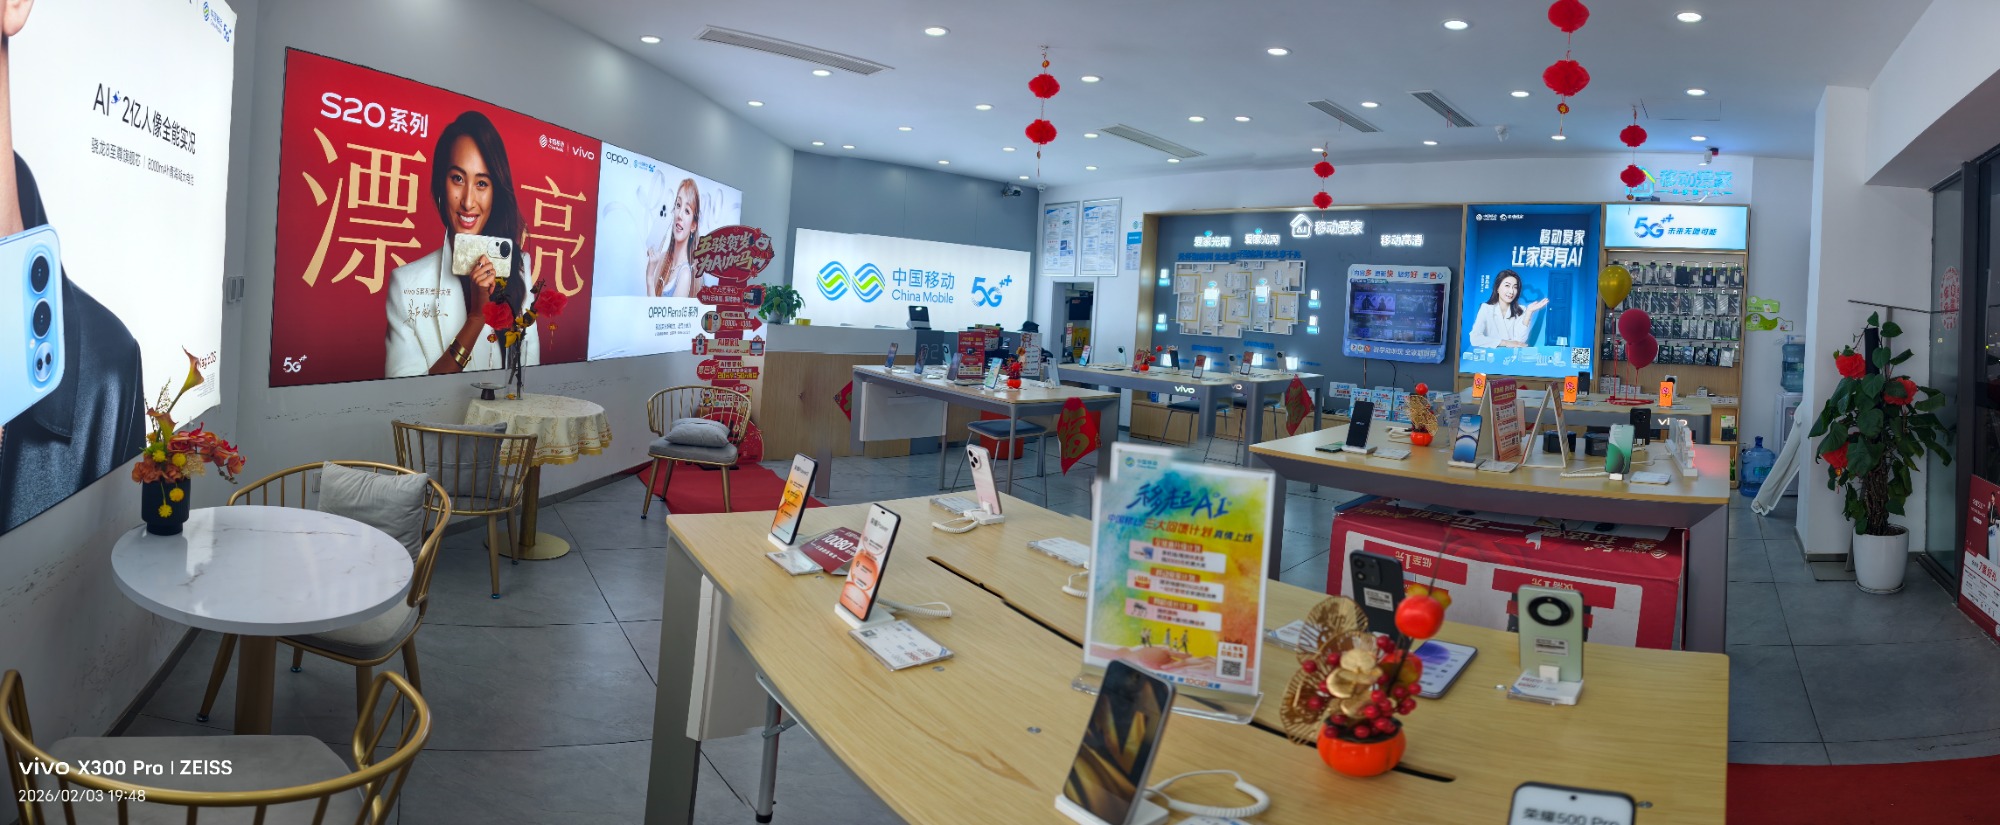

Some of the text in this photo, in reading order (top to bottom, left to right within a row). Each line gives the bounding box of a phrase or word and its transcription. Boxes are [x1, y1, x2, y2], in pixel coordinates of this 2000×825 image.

[93, 83, 196, 155] AI 2亿人像全能实况
[572, 146, 595, 160] vivo
[302, 127, 587, 297] 漂 亮
[1540, 229, 1585, 246] 移动爱家
[1667, 227, 1718, 236] 未来无限可能
[1380, 234, 1424, 247] 移动高清
[1512, 246, 1583, 268] 让家更有AI
[892, 267, 955, 290] 中国移动
[892, 289, 954, 304] China Mobile
[1174, 385, 1196, 394] vivo
[1395, 550, 1432, 570] 低至1元
